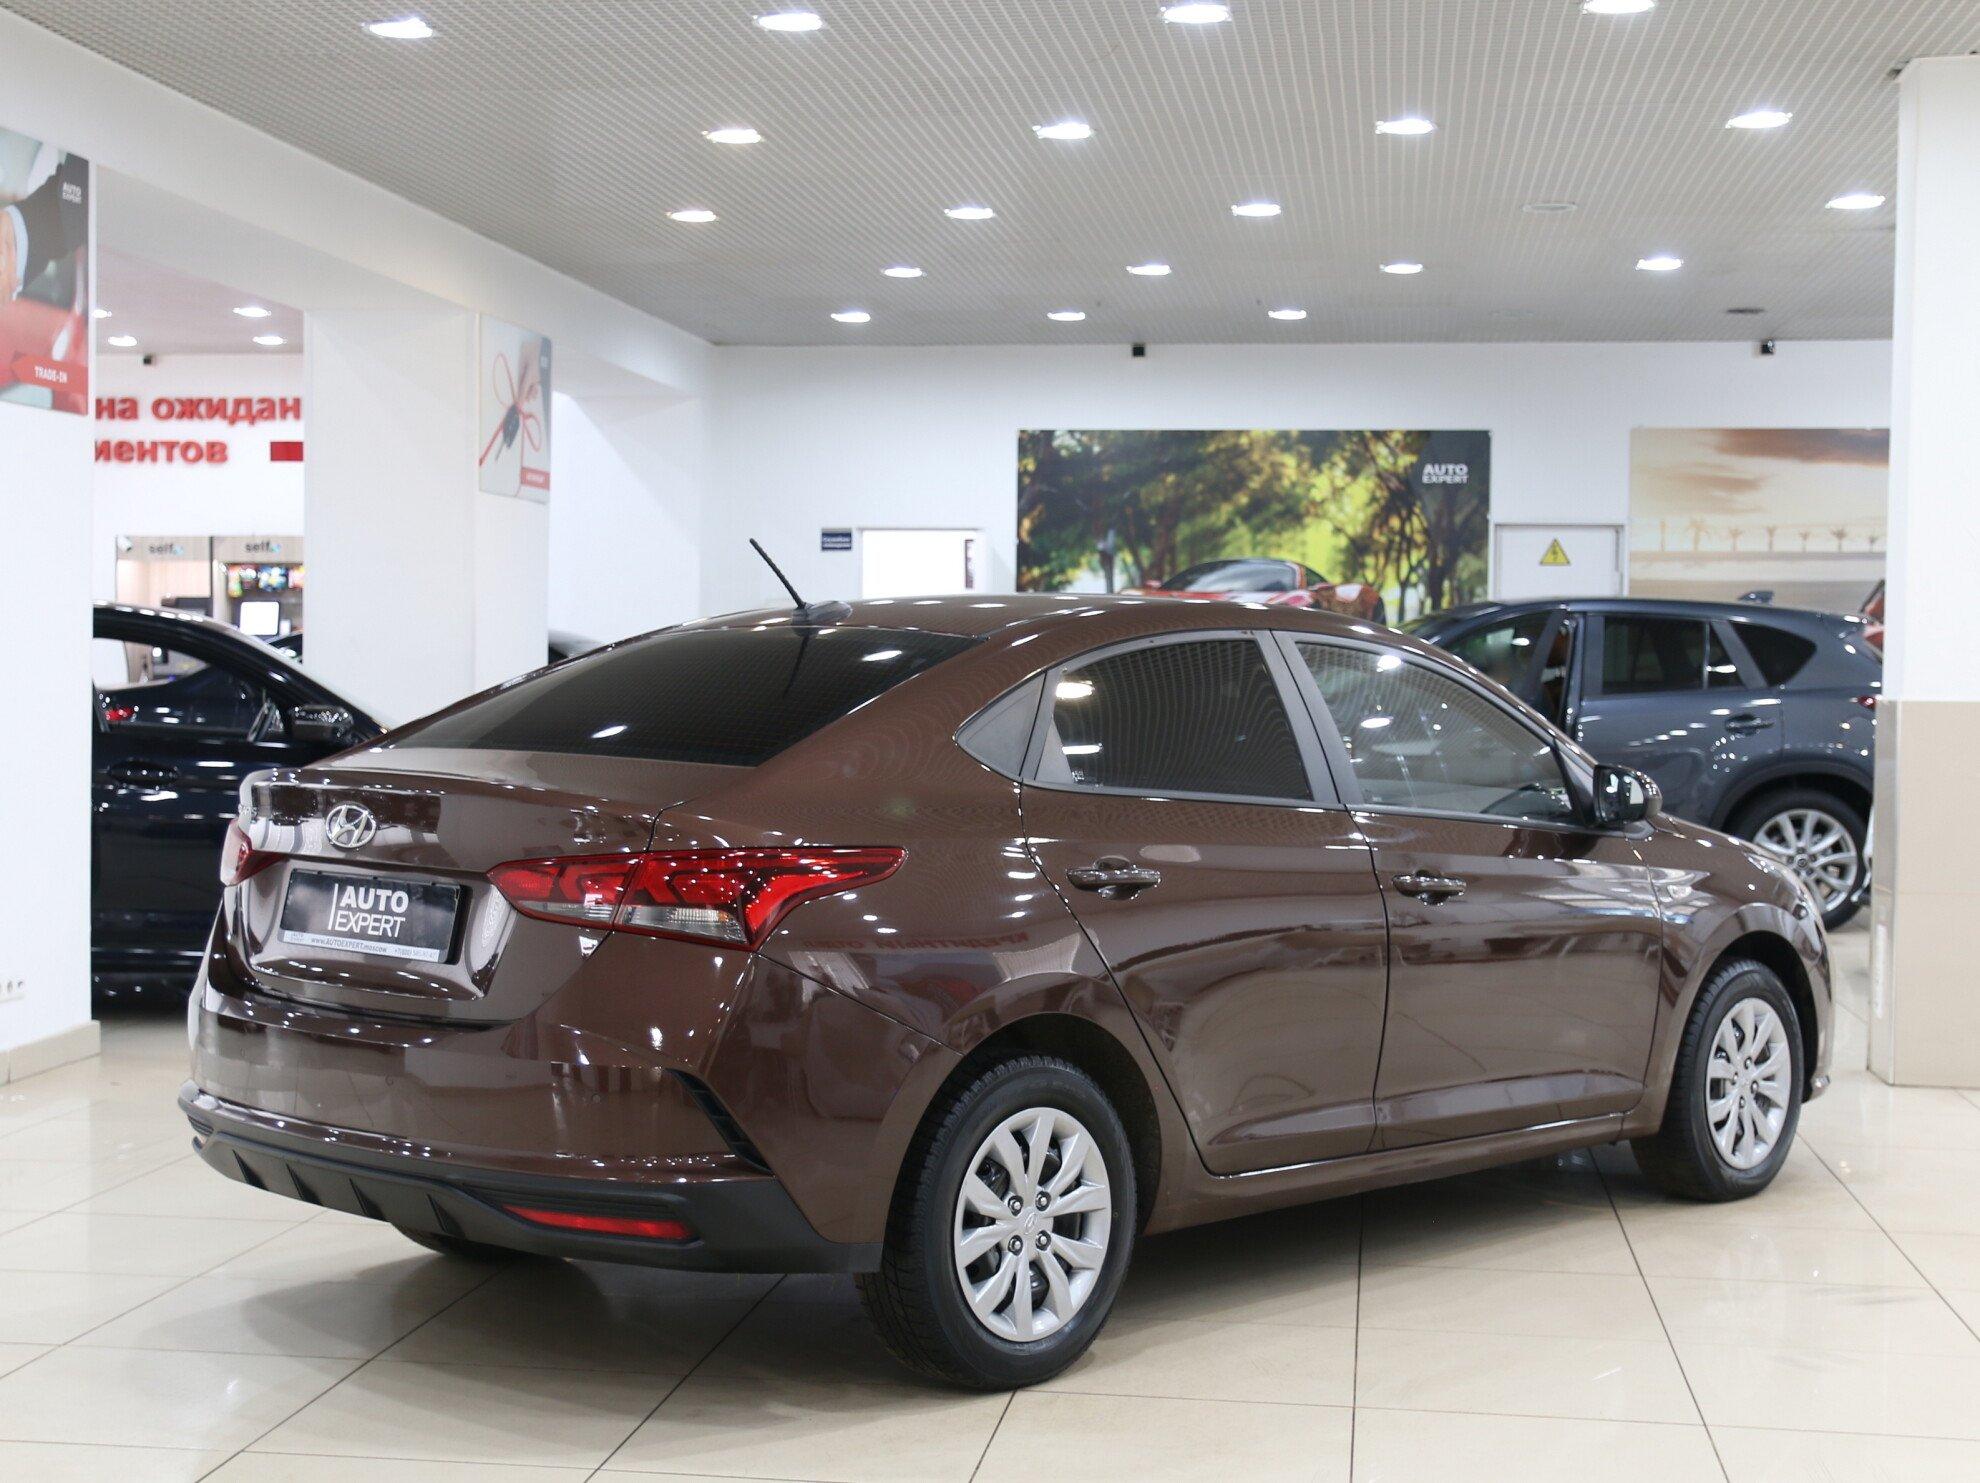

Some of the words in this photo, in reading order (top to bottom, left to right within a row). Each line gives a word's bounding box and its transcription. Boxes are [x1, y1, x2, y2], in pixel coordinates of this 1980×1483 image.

[95, 396, 139, 421] на
[151, 396, 302, 427] ожидан
[1422, 474, 1468, 484] EXPERT
[1423, 463, 1468, 475] AUTO
[339, 885, 409, 914] AUTO
[335, 910, 406, 938] EXPERT
